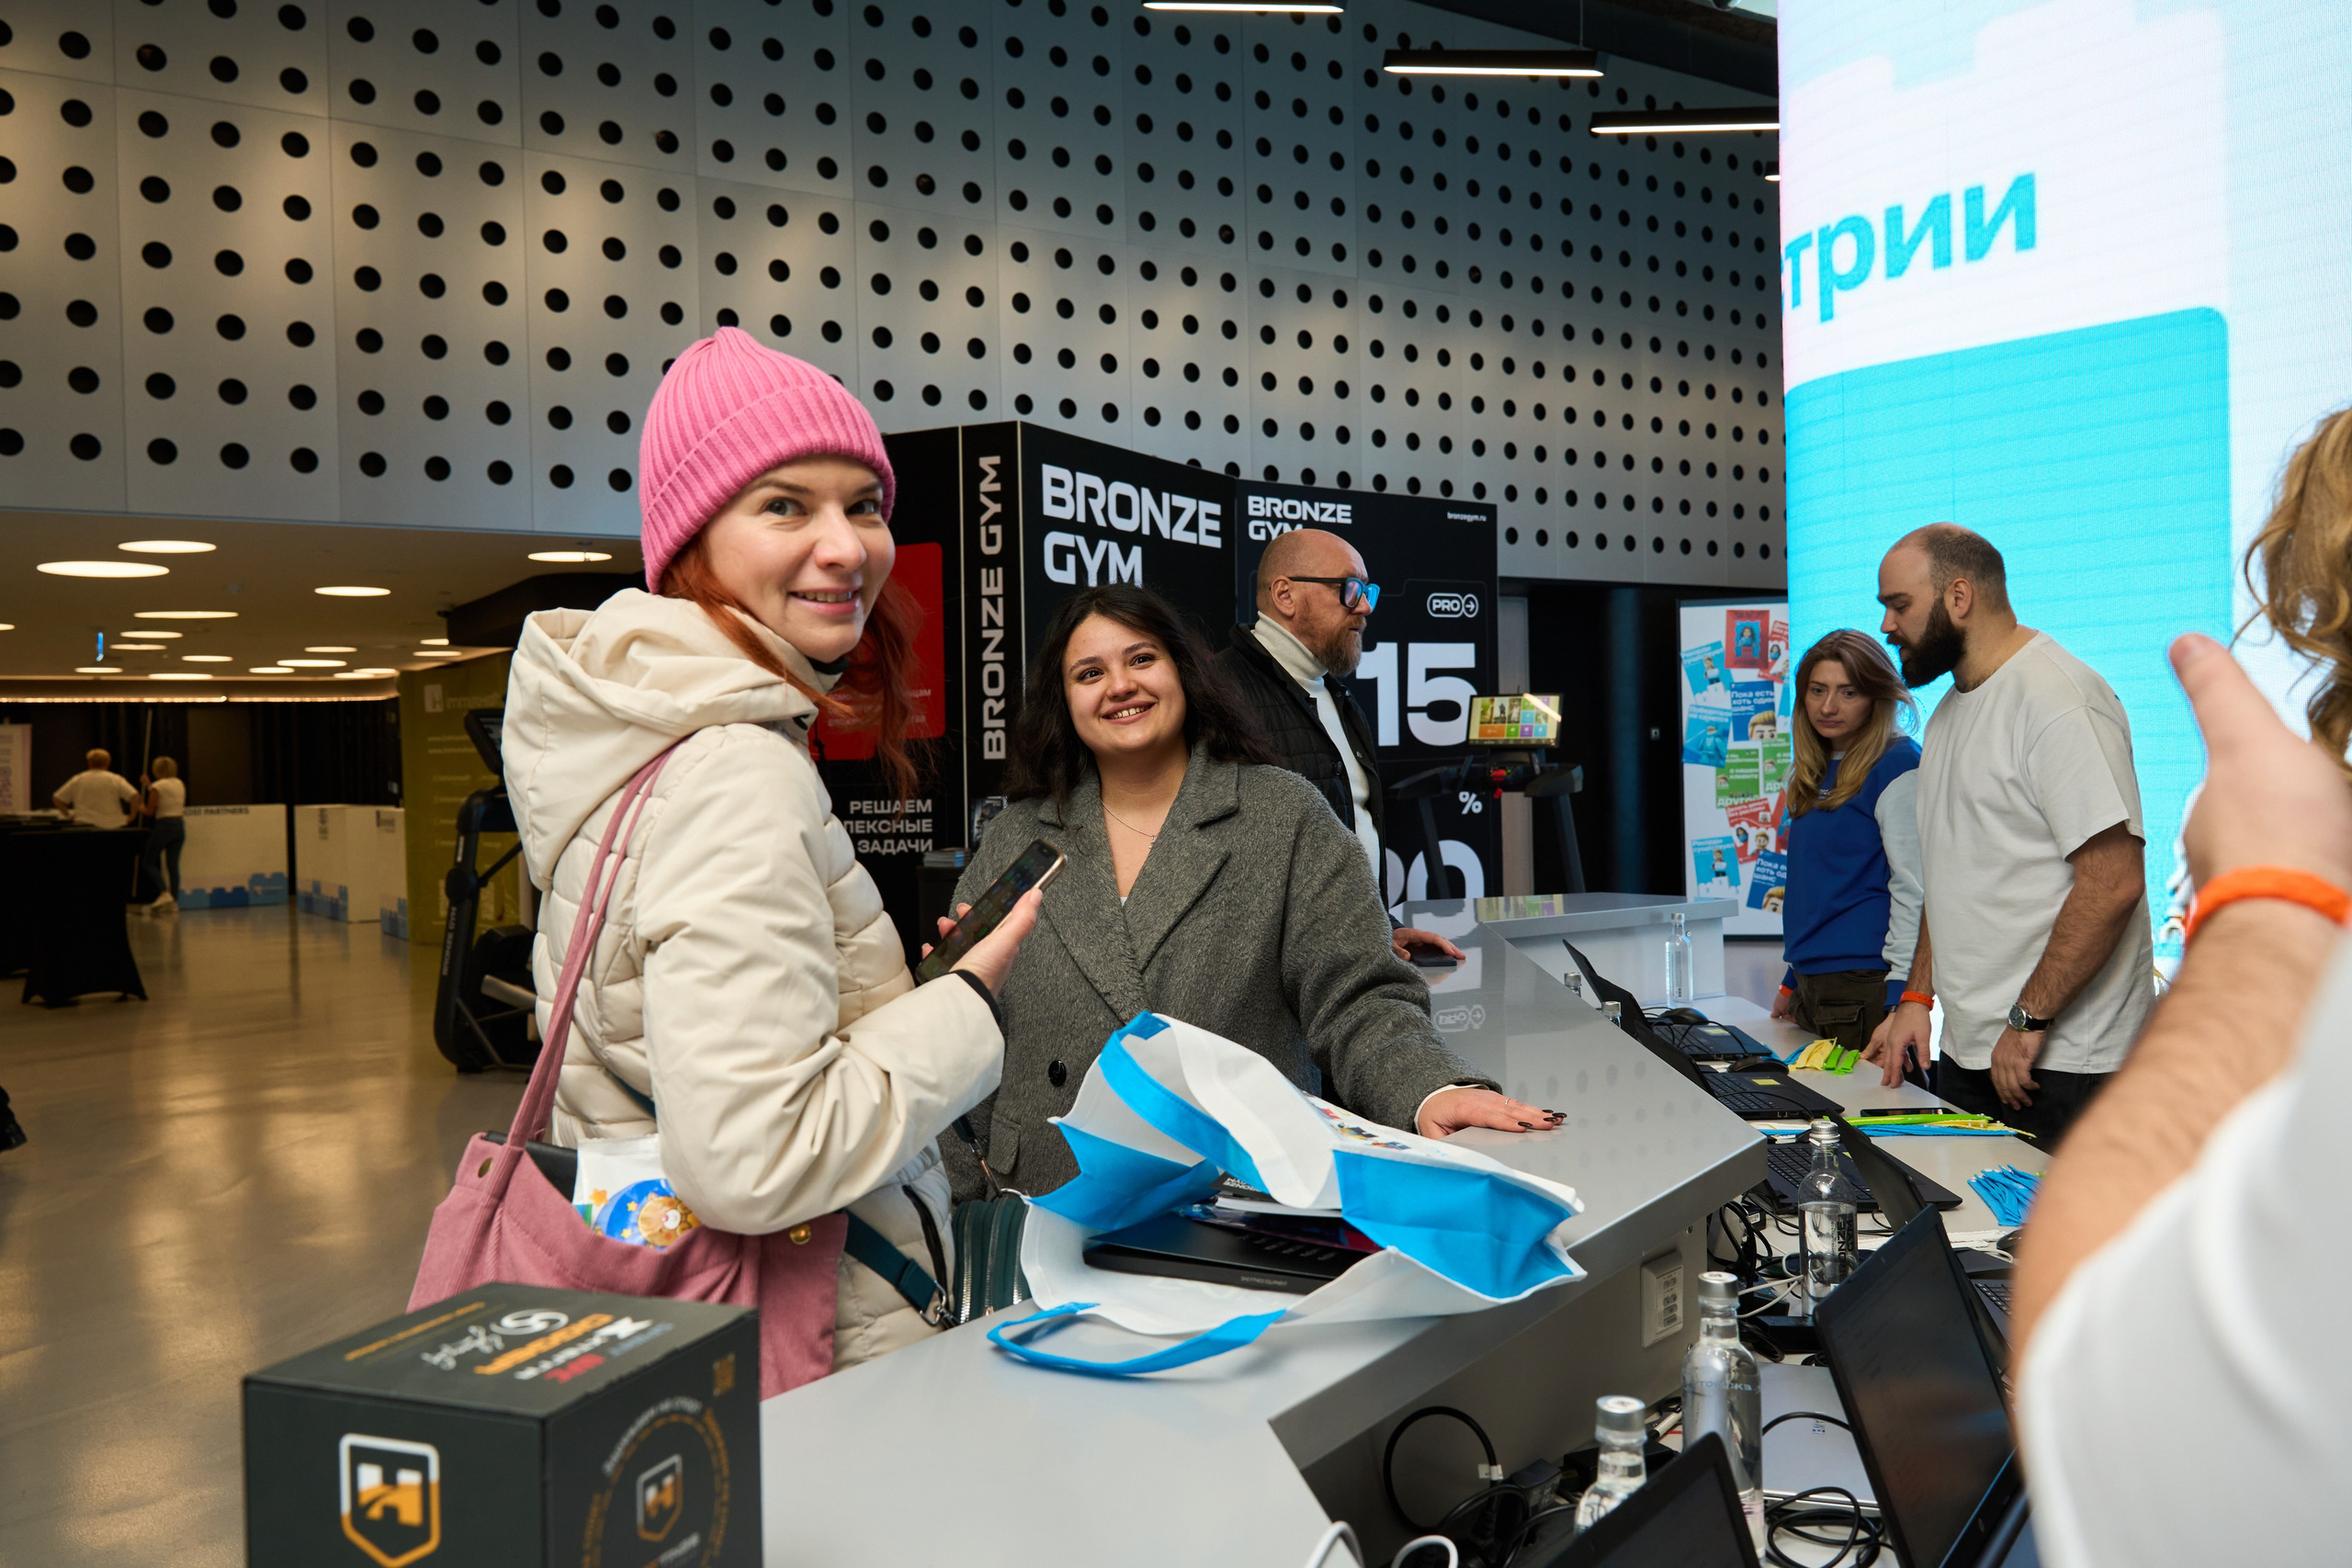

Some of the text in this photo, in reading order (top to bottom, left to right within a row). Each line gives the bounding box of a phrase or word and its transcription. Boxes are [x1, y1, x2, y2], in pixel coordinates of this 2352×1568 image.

[1781, 172, 2036, 322] трии
[1041, 463, 1222, 549] BRONZE
[1248, 495, 1352, 524] BRONZE
[1447, 511, 1487, 523] bronzegym.ru
[1044, 530, 1144, 589] GYM
[979, 455, 1007, 761] BRONZE GYM
[1431, 599, 1462, 612] PRO
[1356, 642, 1477, 747] 15
[1731, 690, 1753, 699] Пока
[849, 798, 933, 815] РЕШАЕМ
[1458, 791, 1483, 815] %
[857, 838, 933, 856] ЗАДАЧИ
[1838, 1219, 1854, 1282] BRONZE GYM
